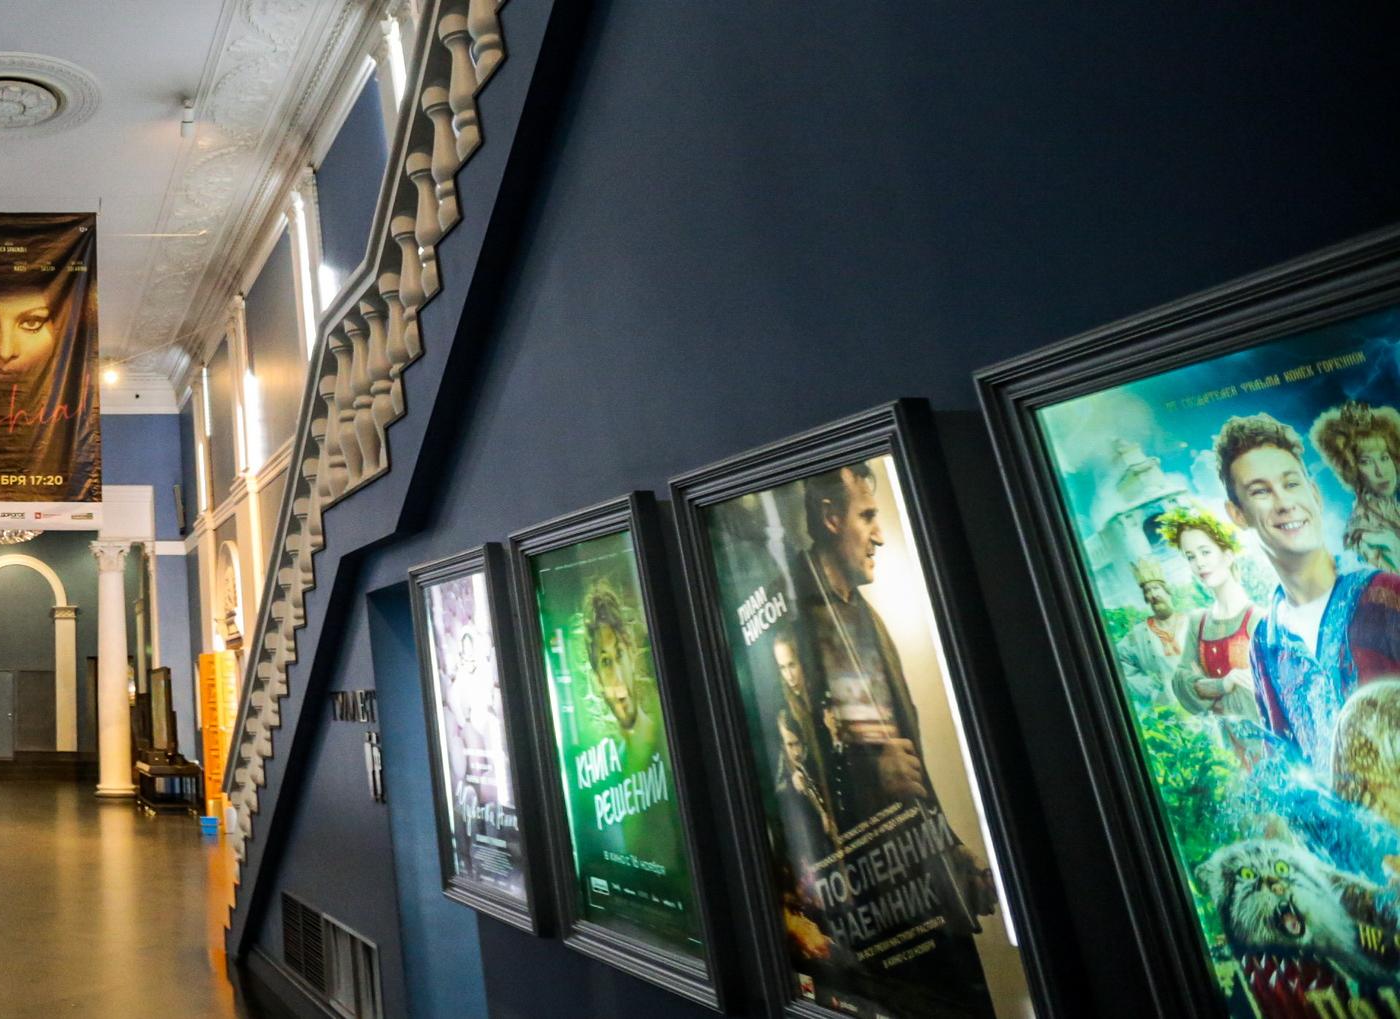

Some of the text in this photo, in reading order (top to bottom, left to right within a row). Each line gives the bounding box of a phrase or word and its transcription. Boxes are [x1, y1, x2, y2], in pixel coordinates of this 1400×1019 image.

[29, 475, 63, 486] 17:20
[737, 586, 768, 625] ЛИАМ
[741, 592, 788, 646] НИСОН
[575, 737, 622, 789] КНИГА
[594, 752, 669, 830] РЕШЕНИЙ
[814, 805, 956, 909] ПОСЛЕДНИЙ
[829, 872, 941, 945] НАЕМНИК
